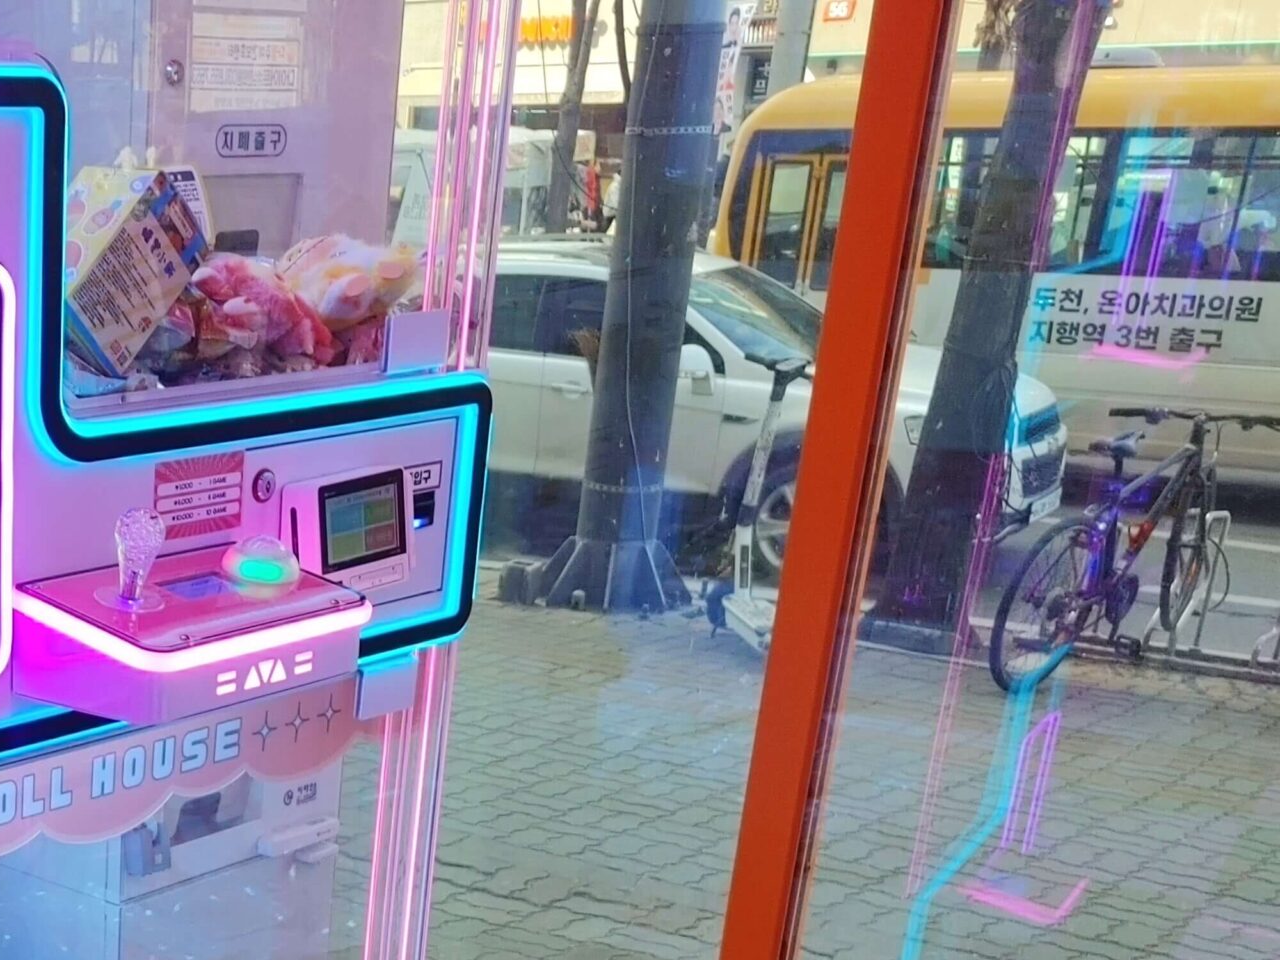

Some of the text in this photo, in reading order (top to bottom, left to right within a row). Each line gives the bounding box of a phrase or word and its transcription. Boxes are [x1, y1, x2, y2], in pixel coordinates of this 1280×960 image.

[1097, 290, 1263, 323] 온아치과의원
[1029, 321, 1223, 354] 지행역 3번 출구
[410, 468, 431, 485] 입구
[91, 718, 243, 799] HOUSE
